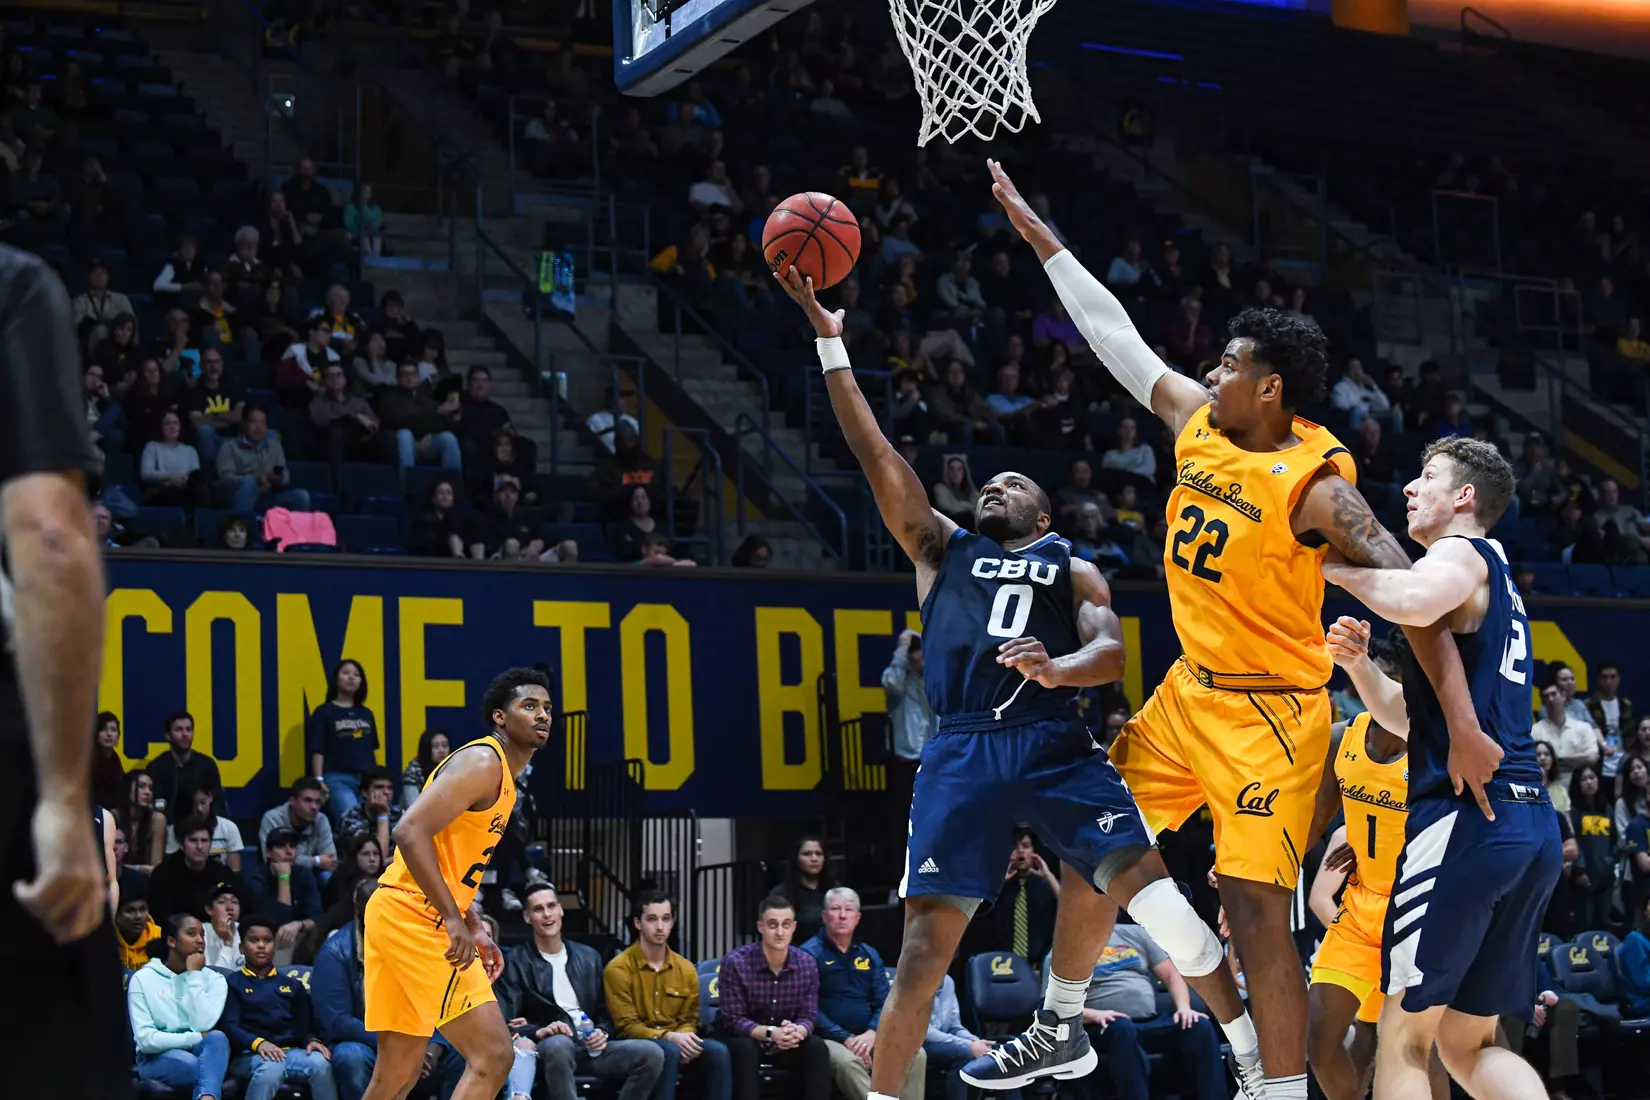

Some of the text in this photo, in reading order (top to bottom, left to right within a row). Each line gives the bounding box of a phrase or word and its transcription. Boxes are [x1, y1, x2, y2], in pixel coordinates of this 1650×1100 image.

[1178, 459, 1263, 520] Golden Bears
[1171, 504, 1230, 584] 22
[970, 557, 1060, 586] CBU
[986, 583, 1034, 639] 0
[533, 600, 696, 791] TO
[1234, 781, 1280, 818] Cal
[1366, 813, 1377, 860] 1
[917, 866, 940, 874] adidas
[853, 956, 871, 971] Cal
[991, 955, 1015, 976] Cal
